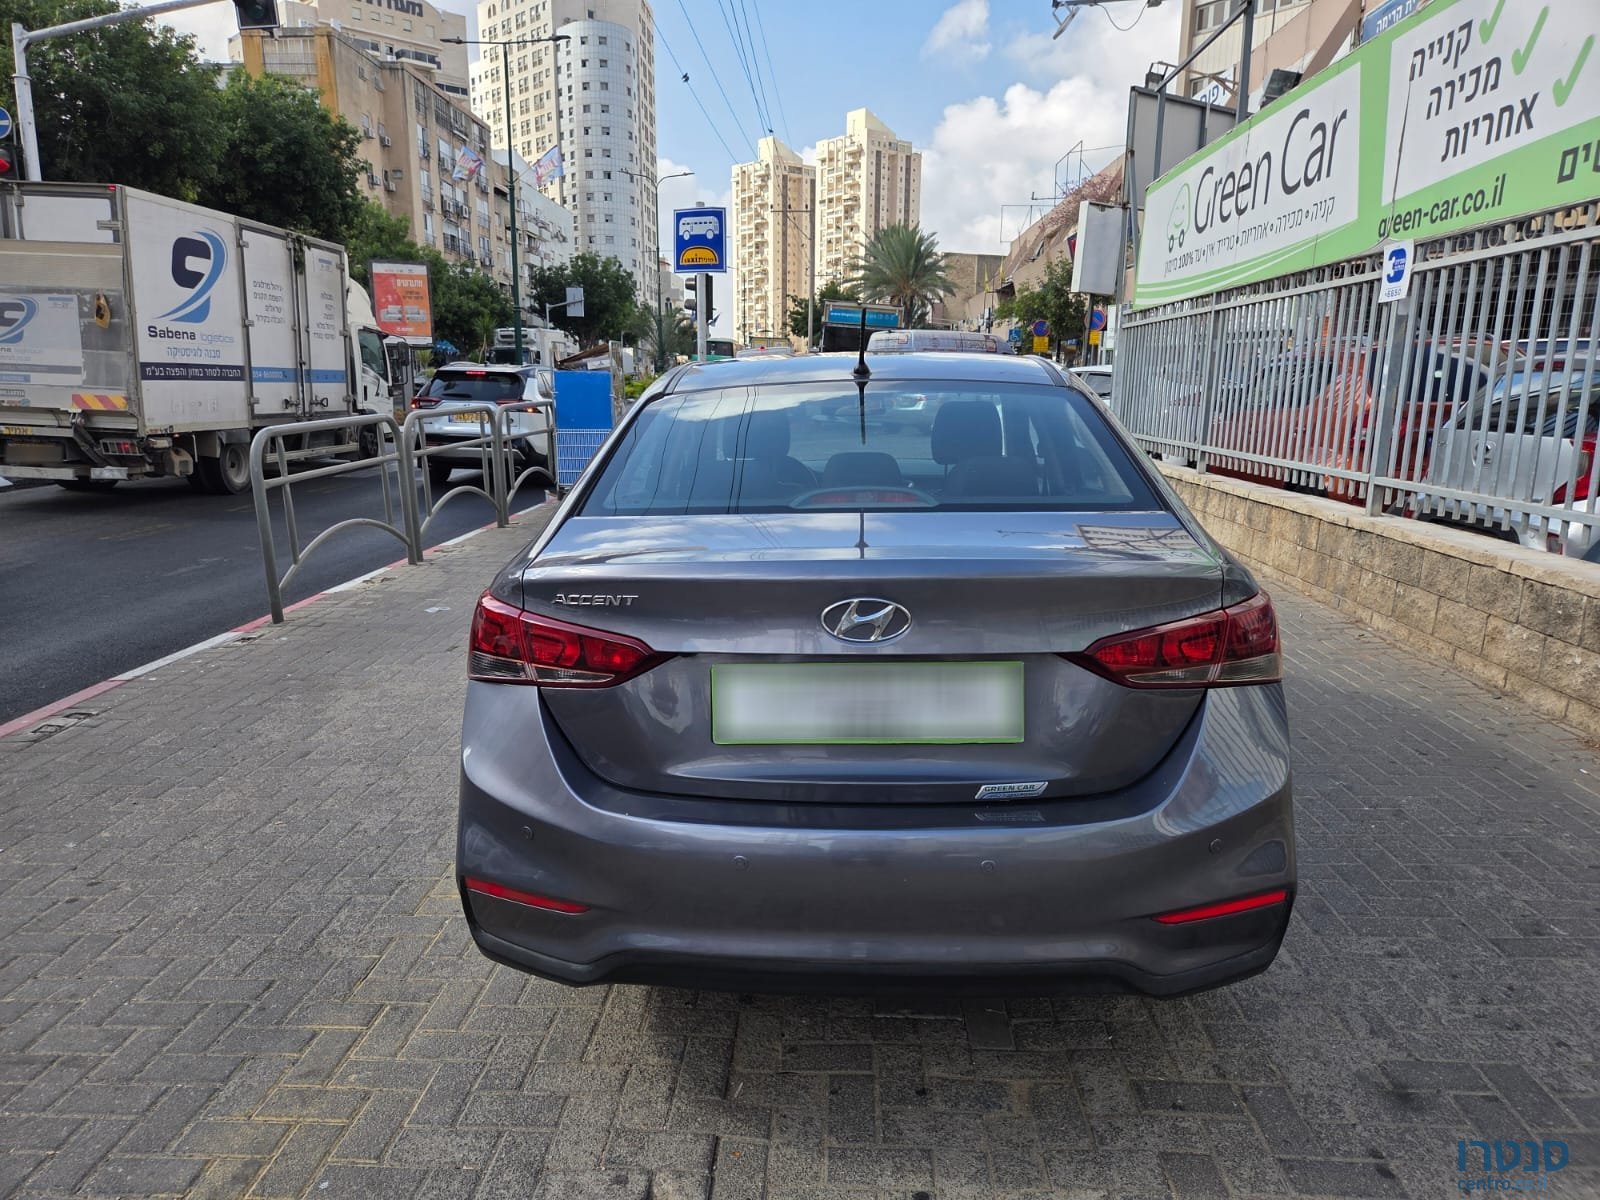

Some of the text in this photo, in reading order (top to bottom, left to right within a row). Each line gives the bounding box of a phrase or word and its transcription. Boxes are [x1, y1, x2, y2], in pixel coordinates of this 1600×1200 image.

[1409, 19, 1473, 82] קנייה
[1426, 56, 1502, 121] מכירה
[1441, 91, 1540, 163] אחריות
[1195, 108, 1348, 234] Green Car
[1311, 196, 1336, 223] קניה
[1274, 208, 1303, 233] מכירה
[1239, 221, 1270, 246] אחריות
[1178, 251, 1194, 269] 100%
[1205, 242, 1216, 264] אין
[148, 325, 196, 341] Sabena
[167, 346, 202, 359] לוגיסטיקה
[146, 366, 165, 376] בע"מ
[166, 367, 187, 376] והפצה
[204, 366, 221, 377] לסחר
[221, 369, 241, 377] החברה
[552, 593, 639, 606] ACCENT
